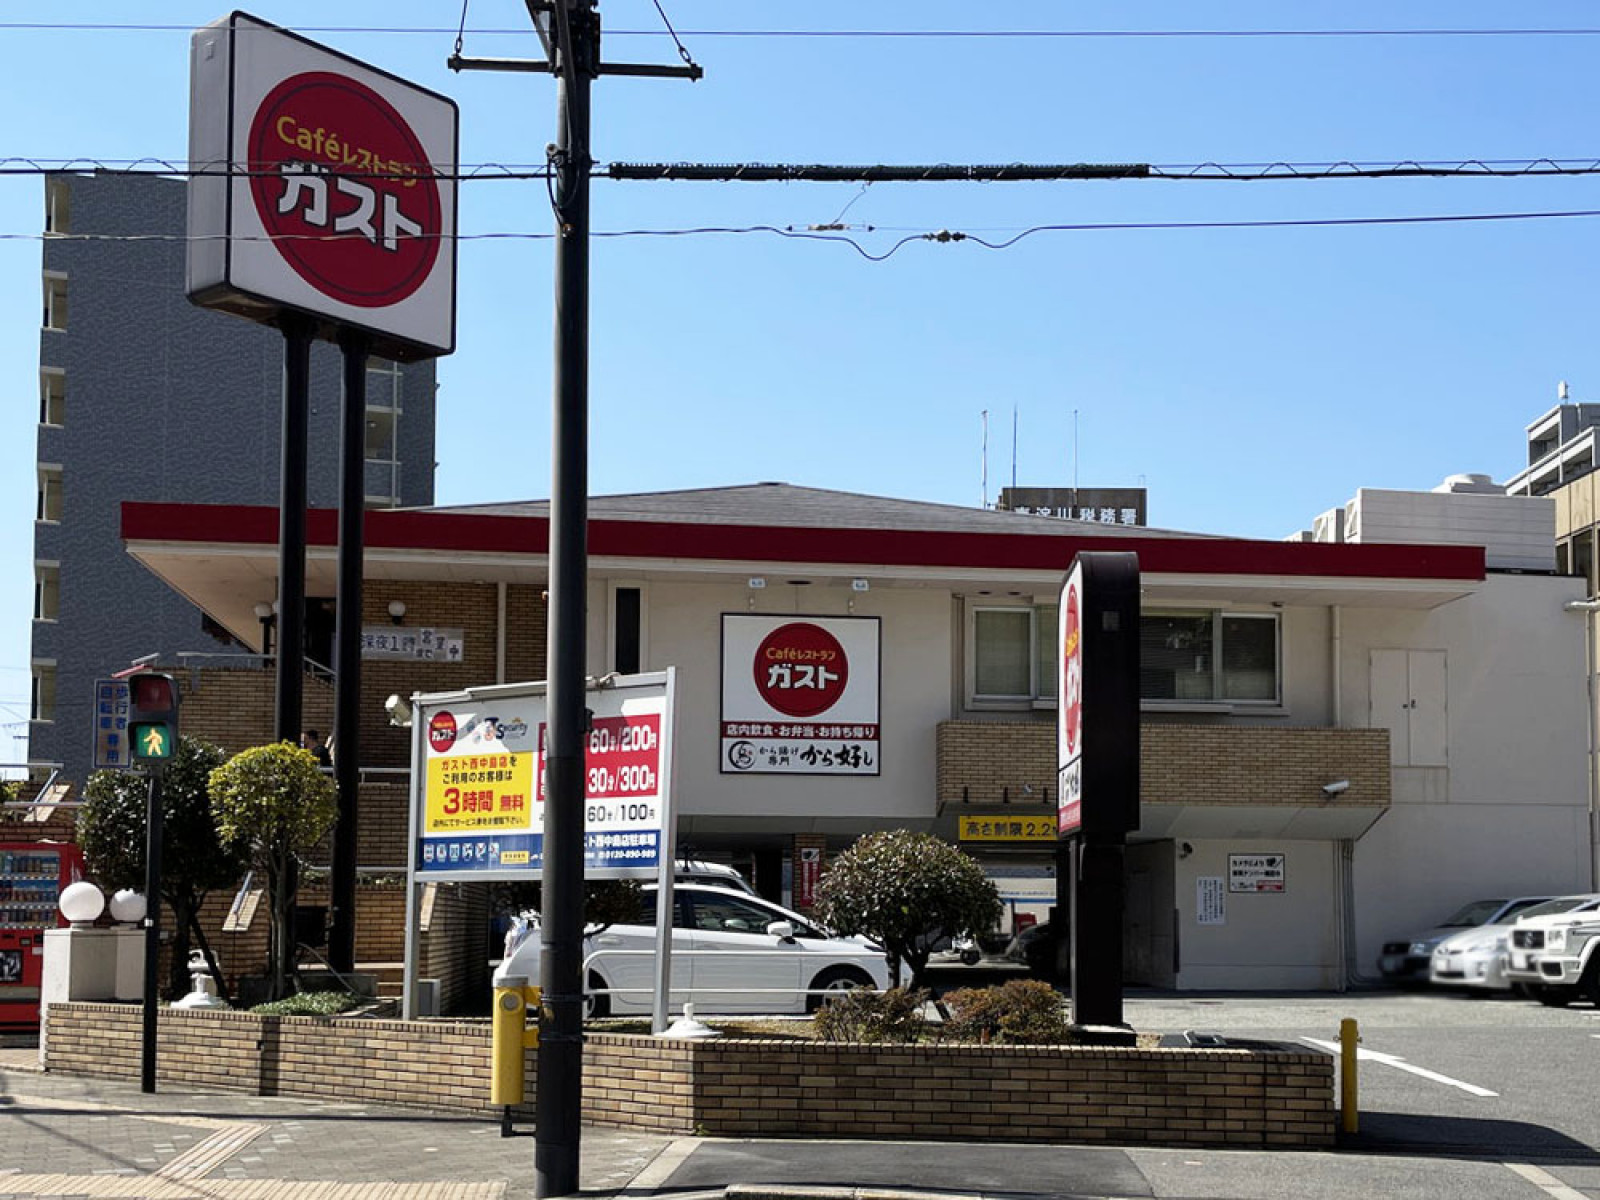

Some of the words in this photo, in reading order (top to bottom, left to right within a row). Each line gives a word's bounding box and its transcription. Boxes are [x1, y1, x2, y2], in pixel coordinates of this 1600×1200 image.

[277, 162, 423, 251] ガスト
[767, 664, 839, 690] ガスト
[799, 744, 874, 768] から好し
[443, 788, 494, 814] 3時間
